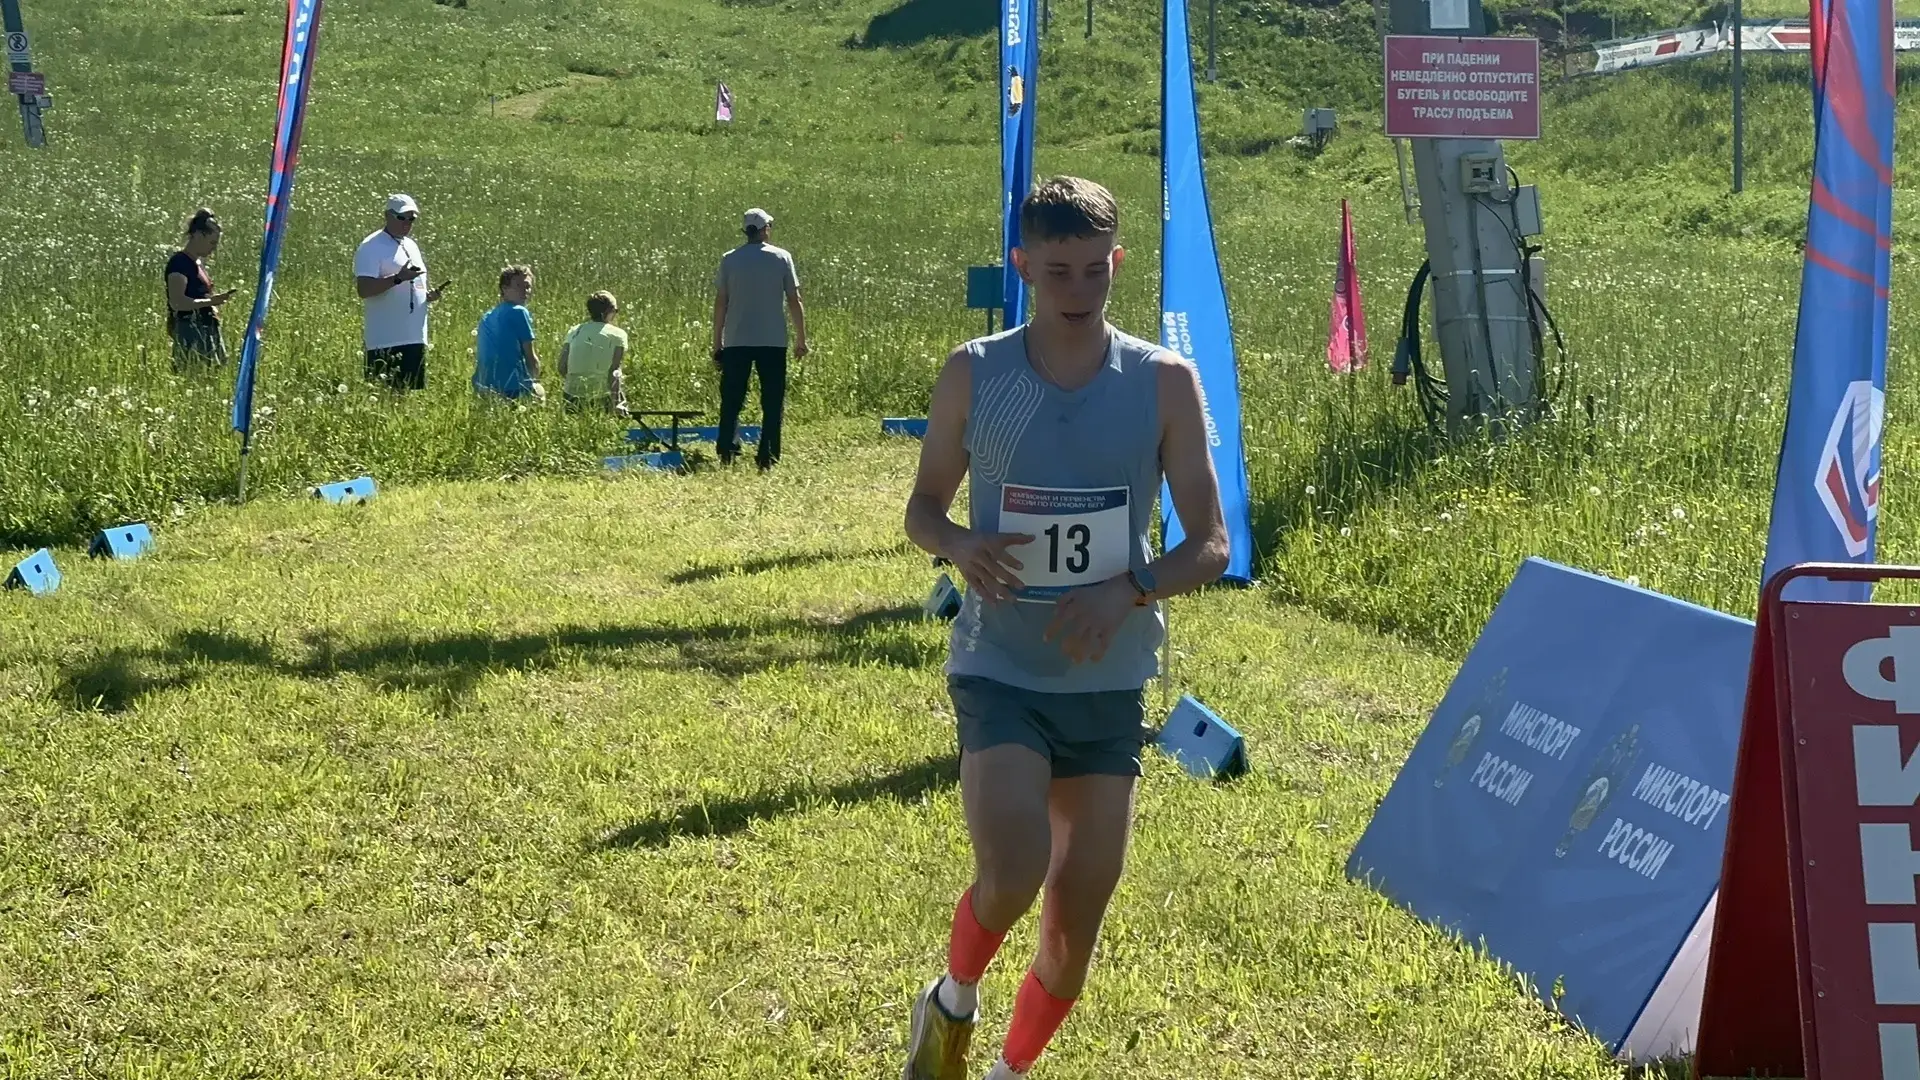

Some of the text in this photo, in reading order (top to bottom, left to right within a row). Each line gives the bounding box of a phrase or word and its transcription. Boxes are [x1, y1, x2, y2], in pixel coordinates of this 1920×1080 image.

[1422, 52, 1500, 66] ПРИ ПАДЕНИИ
[1391, 70, 1534, 84] НЕМЕДЛЕННО ОТПУСТИТЕ
[1397, 88, 1528, 103] БУГЕЛЬ И ОСВОБОДИТЕ
[1412, 107, 1514, 121] ТРАССУ ПОДЪЕМА
[1177, 312, 1193, 355] ФОНД
[1009, 492, 1050, 501] ЧЕМПИОНАТ
[1060, 495, 1106, 503] ПЕРВЕНСТВА
[1009, 498, 1037, 507] РОССИИ
[1044, 523, 1091, 574] 13
[1500, 701, 1582, 761] МИНСПОРТ
[1469, 751, 1534, 806] РОССИИ
[1632, 762, 1730, 830] МИНСПОРТ
[1597, 817, 1674, 880] РОССИИ
